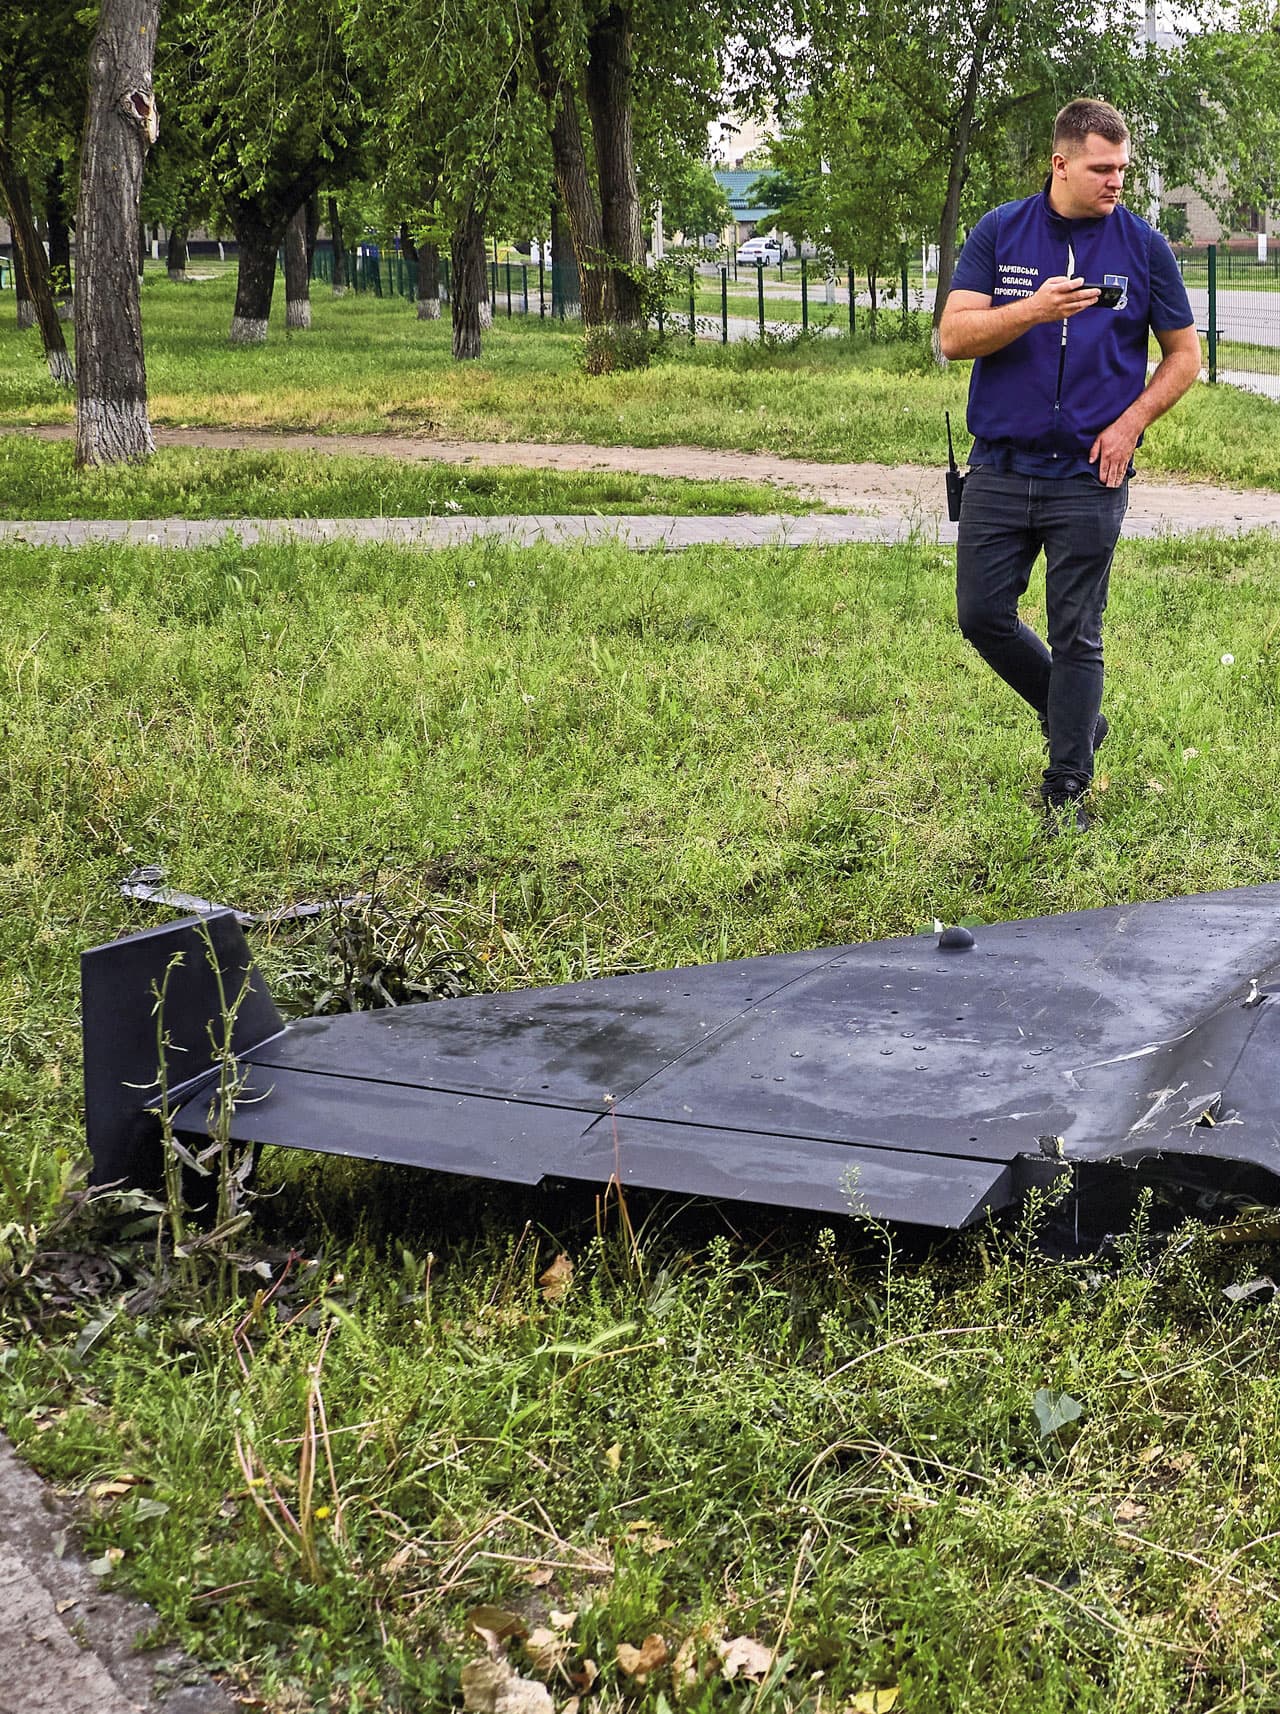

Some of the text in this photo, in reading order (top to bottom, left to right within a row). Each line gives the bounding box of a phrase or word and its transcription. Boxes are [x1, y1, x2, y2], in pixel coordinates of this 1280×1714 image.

[998, 265, 1039, 276] ХАРКІВСЬКА
[1002, 277, 1032, 286] ОБЛАСНА
[994, 288, 1034, 297] ПРОКУРАТУР
